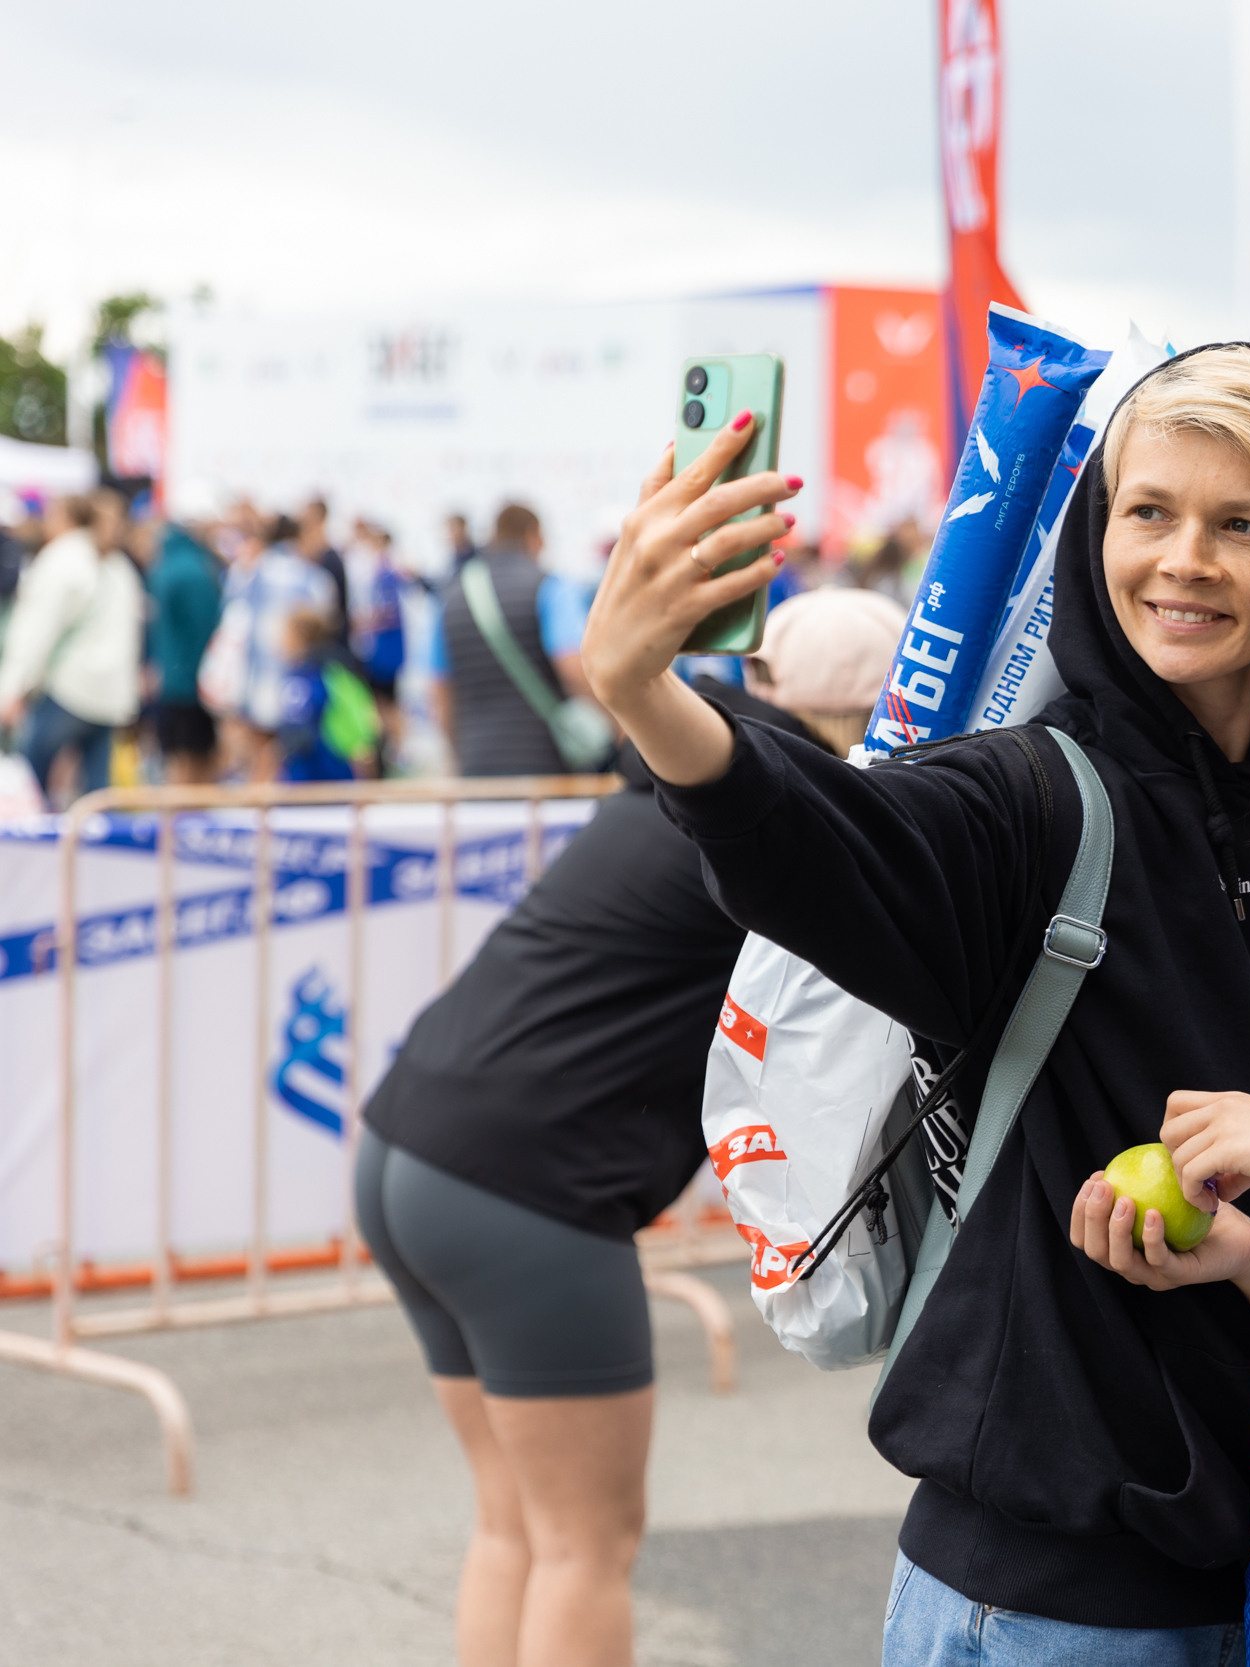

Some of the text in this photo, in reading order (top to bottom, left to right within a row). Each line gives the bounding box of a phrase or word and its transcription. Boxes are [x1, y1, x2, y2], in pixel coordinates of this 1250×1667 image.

[994, 453, 1026, 531] ЛИГА ГЕРОЕВ
[982, 643, 1036, 726] ОДНОМ
